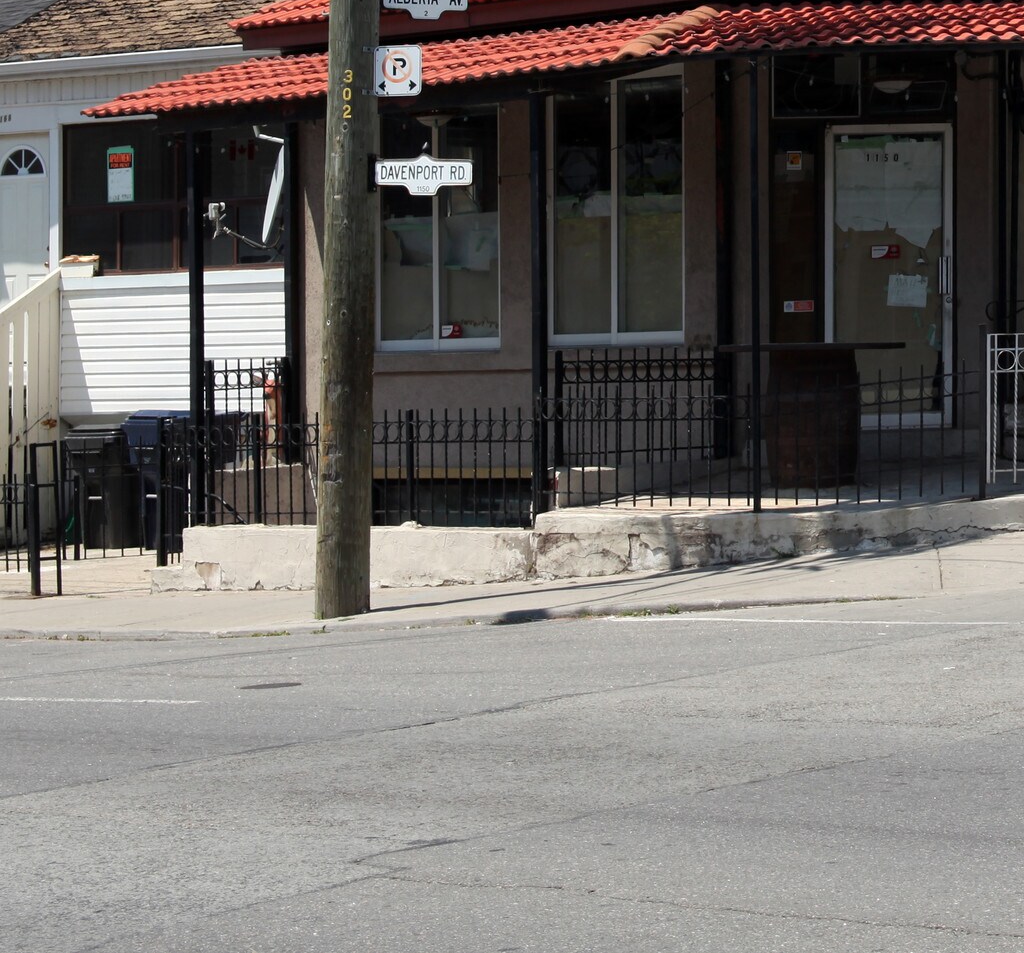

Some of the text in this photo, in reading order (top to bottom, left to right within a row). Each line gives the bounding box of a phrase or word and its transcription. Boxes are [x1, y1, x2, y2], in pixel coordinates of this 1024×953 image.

[866, 152, 900, 162] 1150
[380, 165, 467, 181] DAVENPORT RD.
[416, 185, 430, 193] 1150
